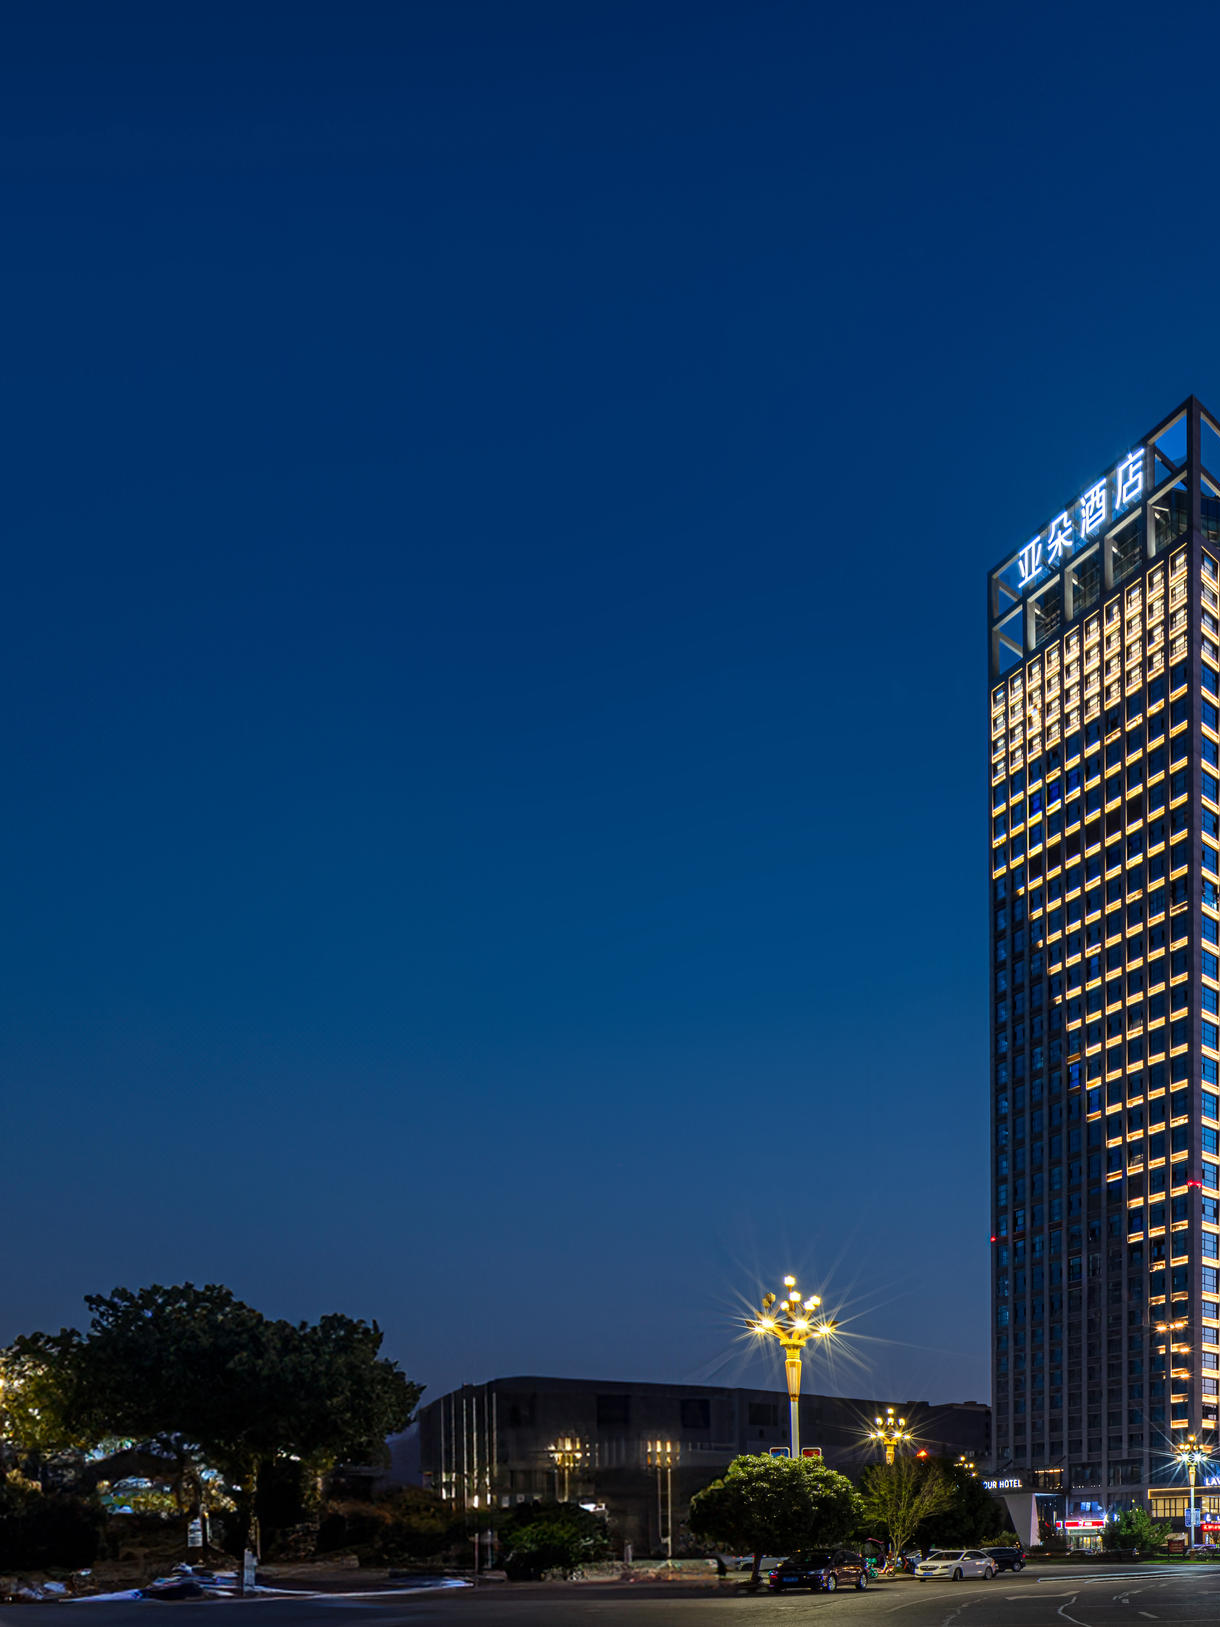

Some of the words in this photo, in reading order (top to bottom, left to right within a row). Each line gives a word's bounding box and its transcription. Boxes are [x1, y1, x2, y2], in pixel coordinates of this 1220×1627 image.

[1016, 448, 1145, 588] 亚朵酒店
[999, 1479, 1023, 1489] HOTEL
